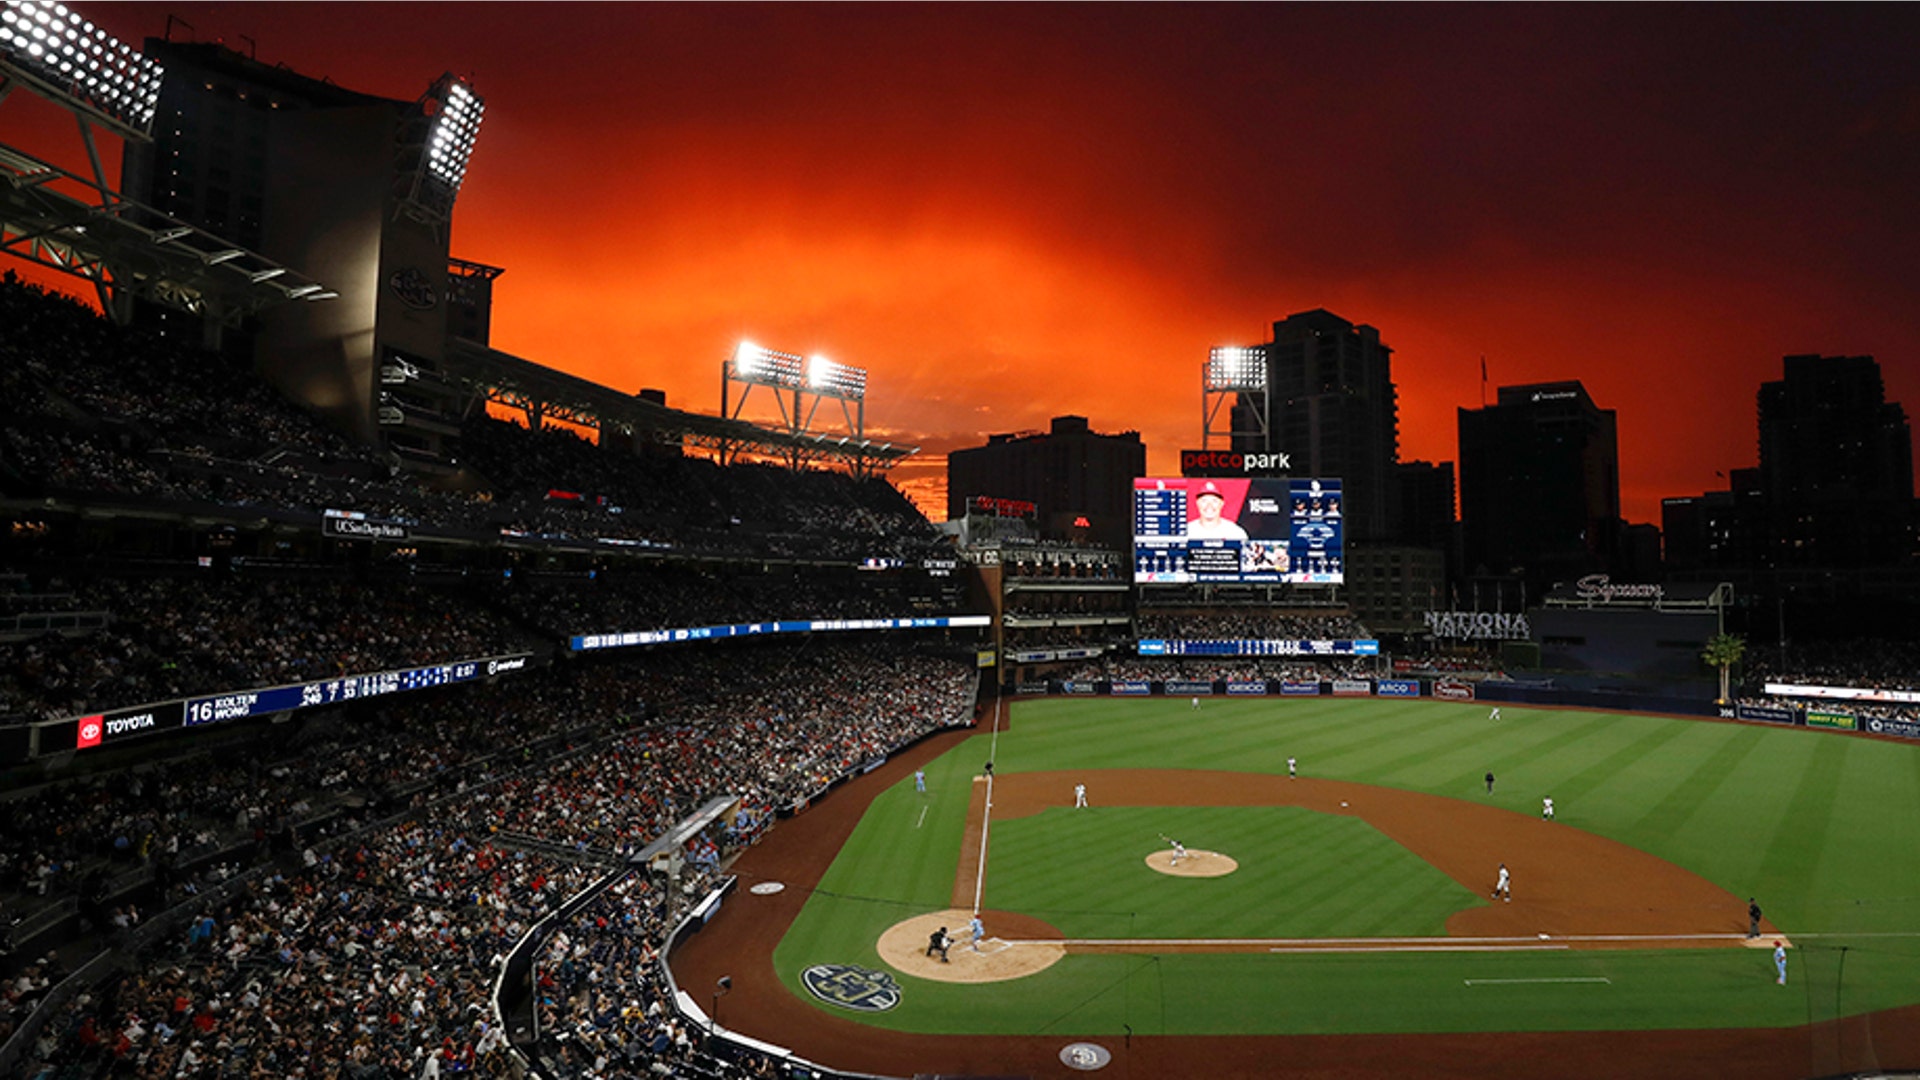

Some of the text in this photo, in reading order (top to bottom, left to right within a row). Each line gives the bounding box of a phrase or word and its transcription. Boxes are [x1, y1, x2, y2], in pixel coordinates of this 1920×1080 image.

[1423, 611, 1529, 629] NATIONA
[1379, 684, 1408, 694] ARCO
[215, 693, 258, 709] KOLTEN
[190, 702, 212, 723] 16
[215, 705, 250, 720] WONG
[106, 713, 154, 735] TOYOTA
